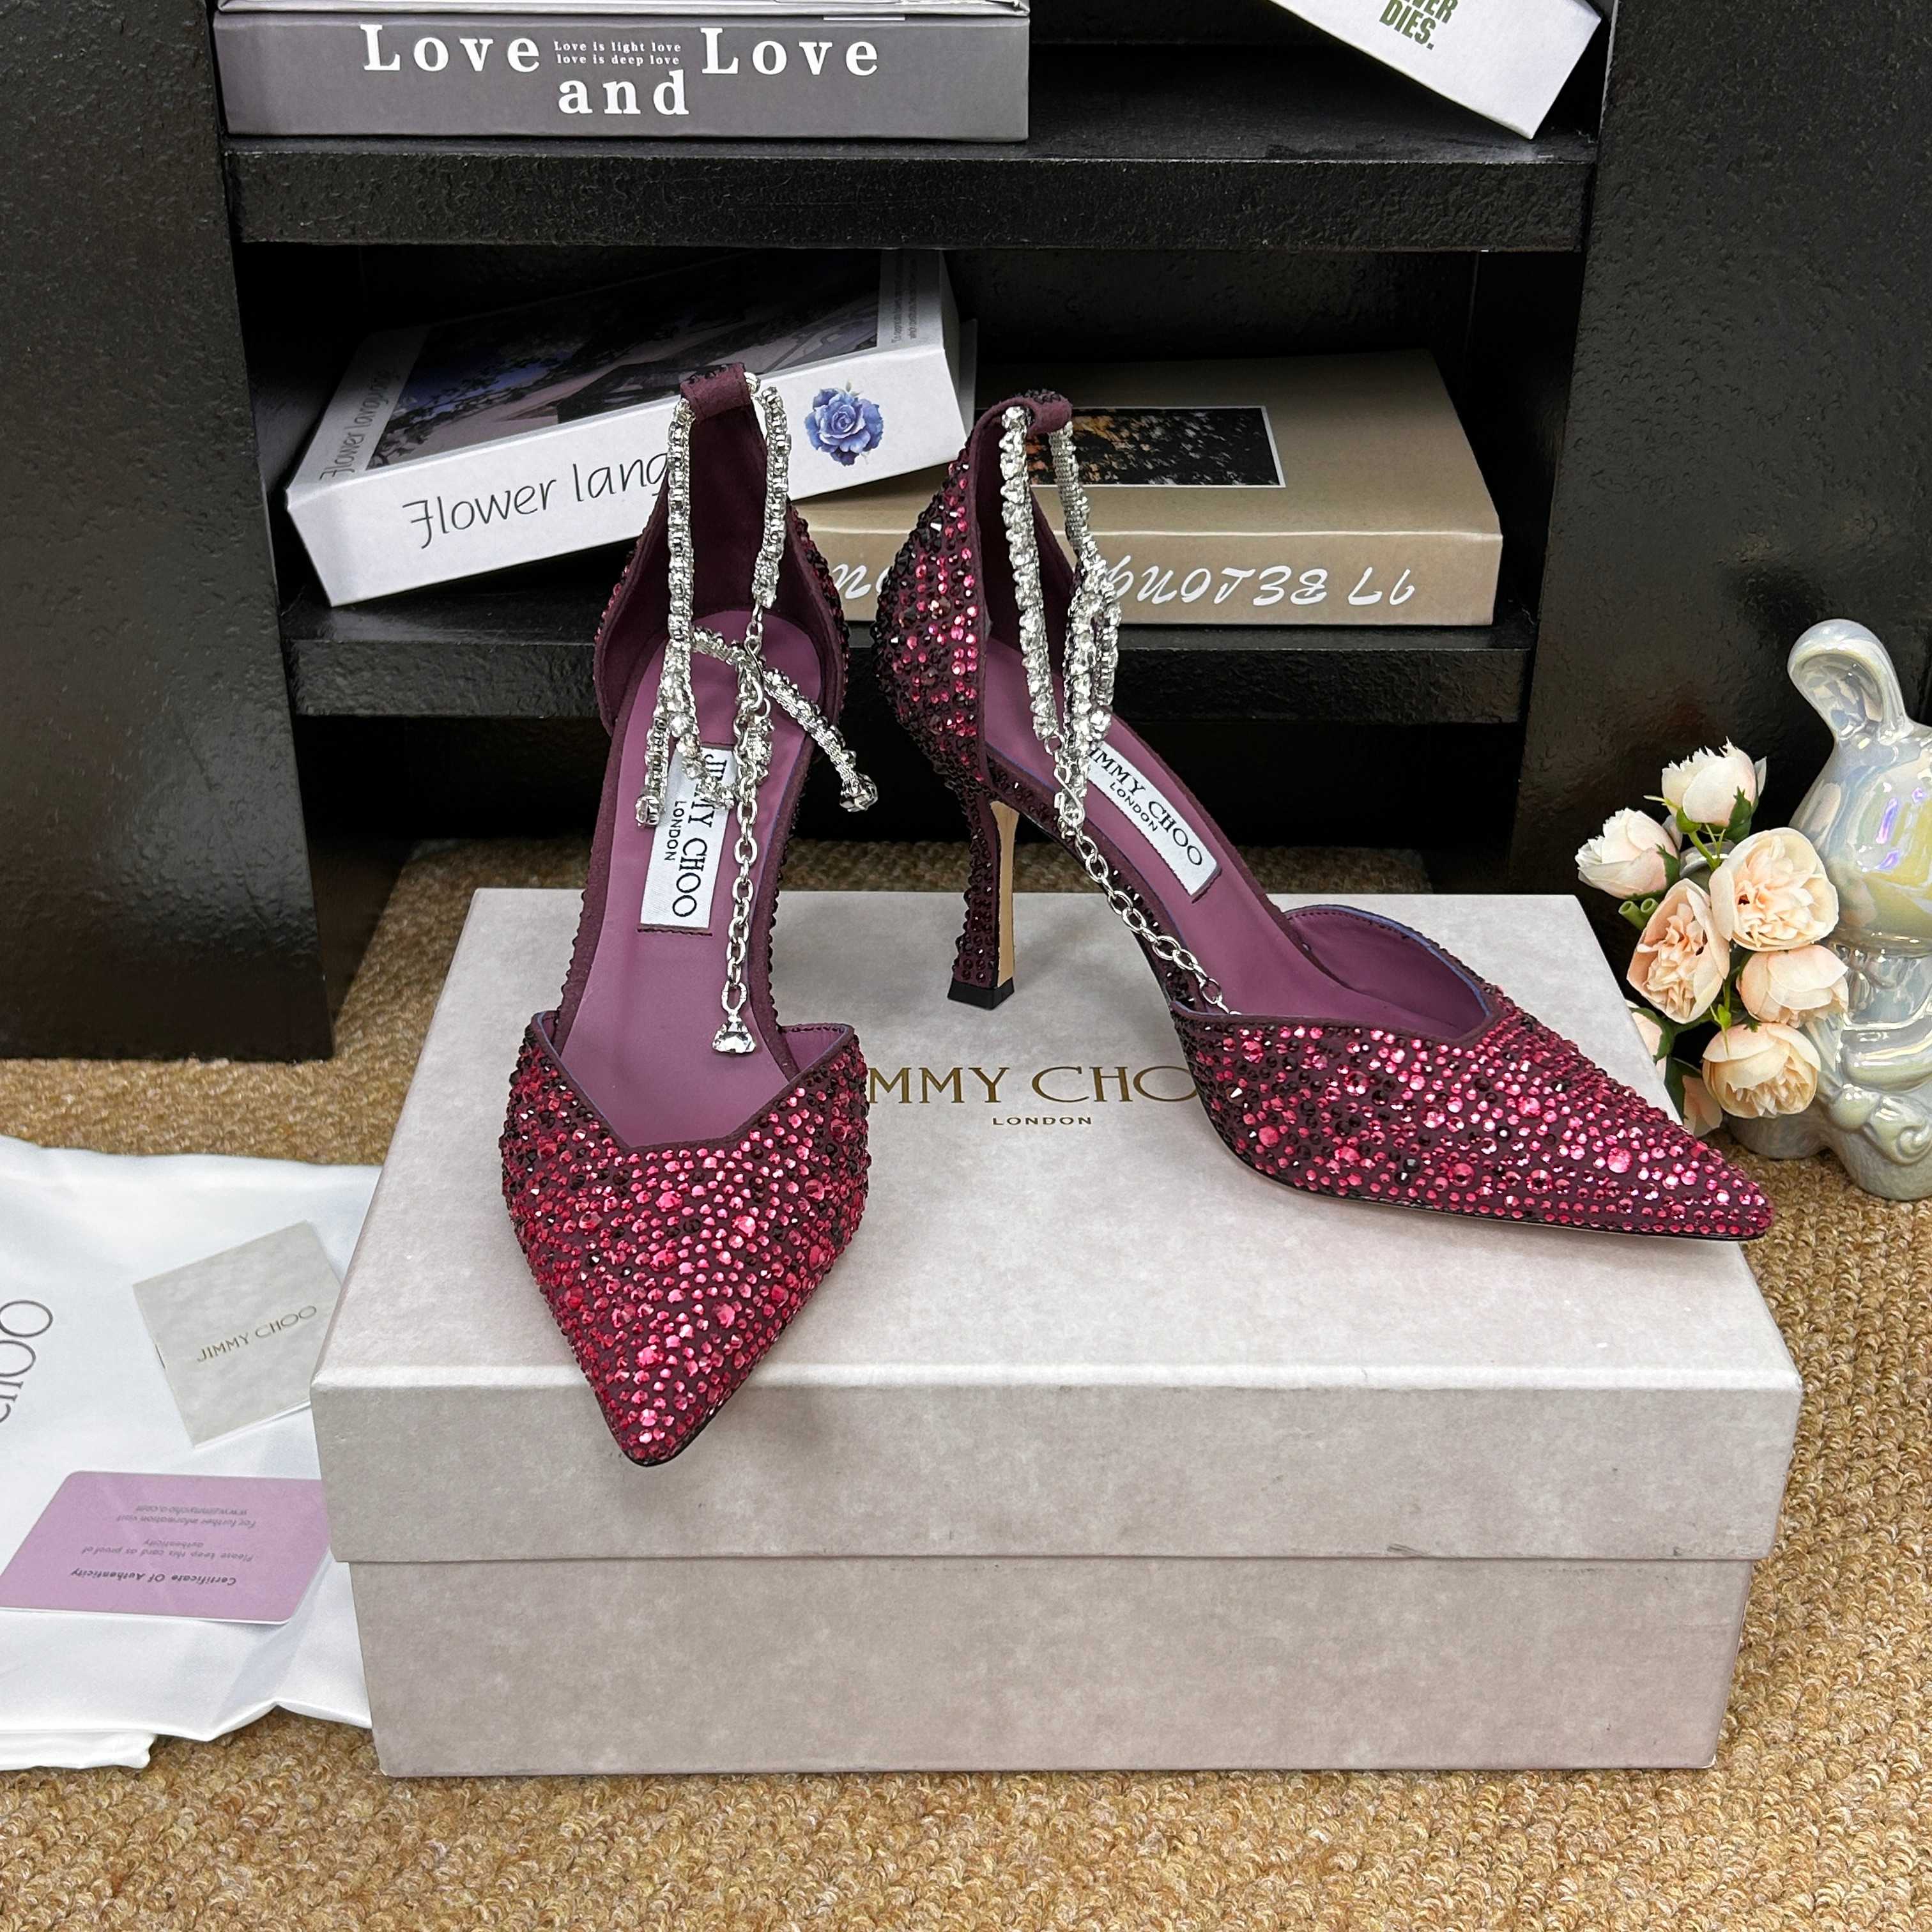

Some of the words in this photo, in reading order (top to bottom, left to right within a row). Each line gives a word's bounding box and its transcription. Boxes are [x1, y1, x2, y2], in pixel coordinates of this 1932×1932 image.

[1379, 0, 1436, 50] DIES.
[360, 24, 540, 73] Love
[701, 27, 878, 76] Love
[554, 41, 586, 51] Love
[594, 42, 604, 51] is
[611, 41, 645, 54] light
[652, 42, 681, 52] love
[557, 54, 586, 64] love
[593, 54, 604, 64] is
[611, 55, 643, 66] deep
[650, 55, 679, 65] love
[558, 69, 689, 115] and
[402, 479, 556, 549] Flower
[573, 452, 668, 503] lang
[1107, 555, 1327, 606] BELONG
[1088, 747, 1146, 794] IMMY
[1149, 801, 1202, 866] CHOO
[1109, 782, 1158, 832] LONDON
[664, 801, 687, 861] LONDON
[672, 837, 708, 917] CHOO
[868, 1067, 1010, 1104] MMY
[1032, 1066, 1197, 1103] CHO
[993, 1117, 1092, 1126] LONDON
[197, 1332, 249, 1362] JIMMY
[256, 1305, 317, 1338] CHOO
[82, 1546, 93, 1554] of
[94, 1546, 123, 1555] proof
[141, 1549, 164, 1557] card
[144, 1538, 204, 1549] authenticity
[220, 1552, 254, 1562] Please
[71, 1568, 146, 1581] Authenticity
[148, 1574, 165, 1583] Of
[171, 1574, 237, 1586] Certificate
